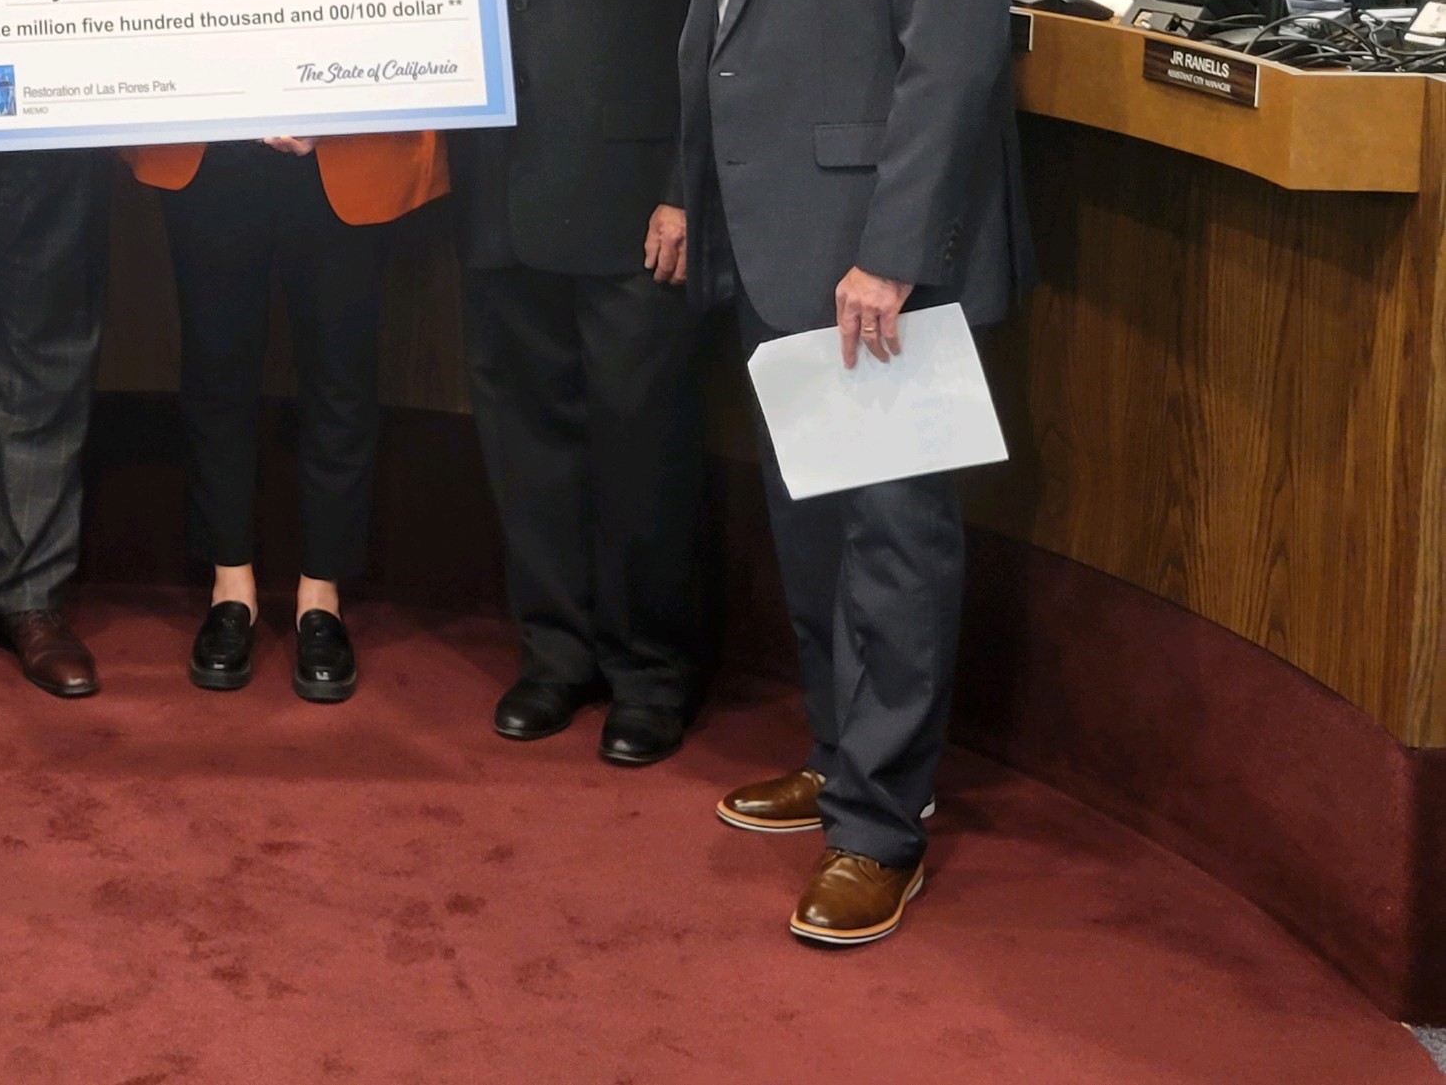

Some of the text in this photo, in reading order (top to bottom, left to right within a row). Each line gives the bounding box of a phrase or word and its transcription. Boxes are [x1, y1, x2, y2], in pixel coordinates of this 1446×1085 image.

[17, 19, 76, 36] million
[82, 18, 114, 33] five
[120, 13, 195, 32] hundred
[201, 7, 285, 28] thousand
[290, 6, 324, 23] and
[329, 2, 387, 20] 00/100
[392, 0, 443, 17] dollar
[297, 59, 458, 83] The State of California
[1170, 50, 1230, 79] JR RANELLS
[23, 80, 176, 98] Restoration of Las Flores Park
[1194, 75, 1204, 85] CITY
[1204, 78, 1231, 93] MANAGER
[22, 106, 49, 115] MEMO
